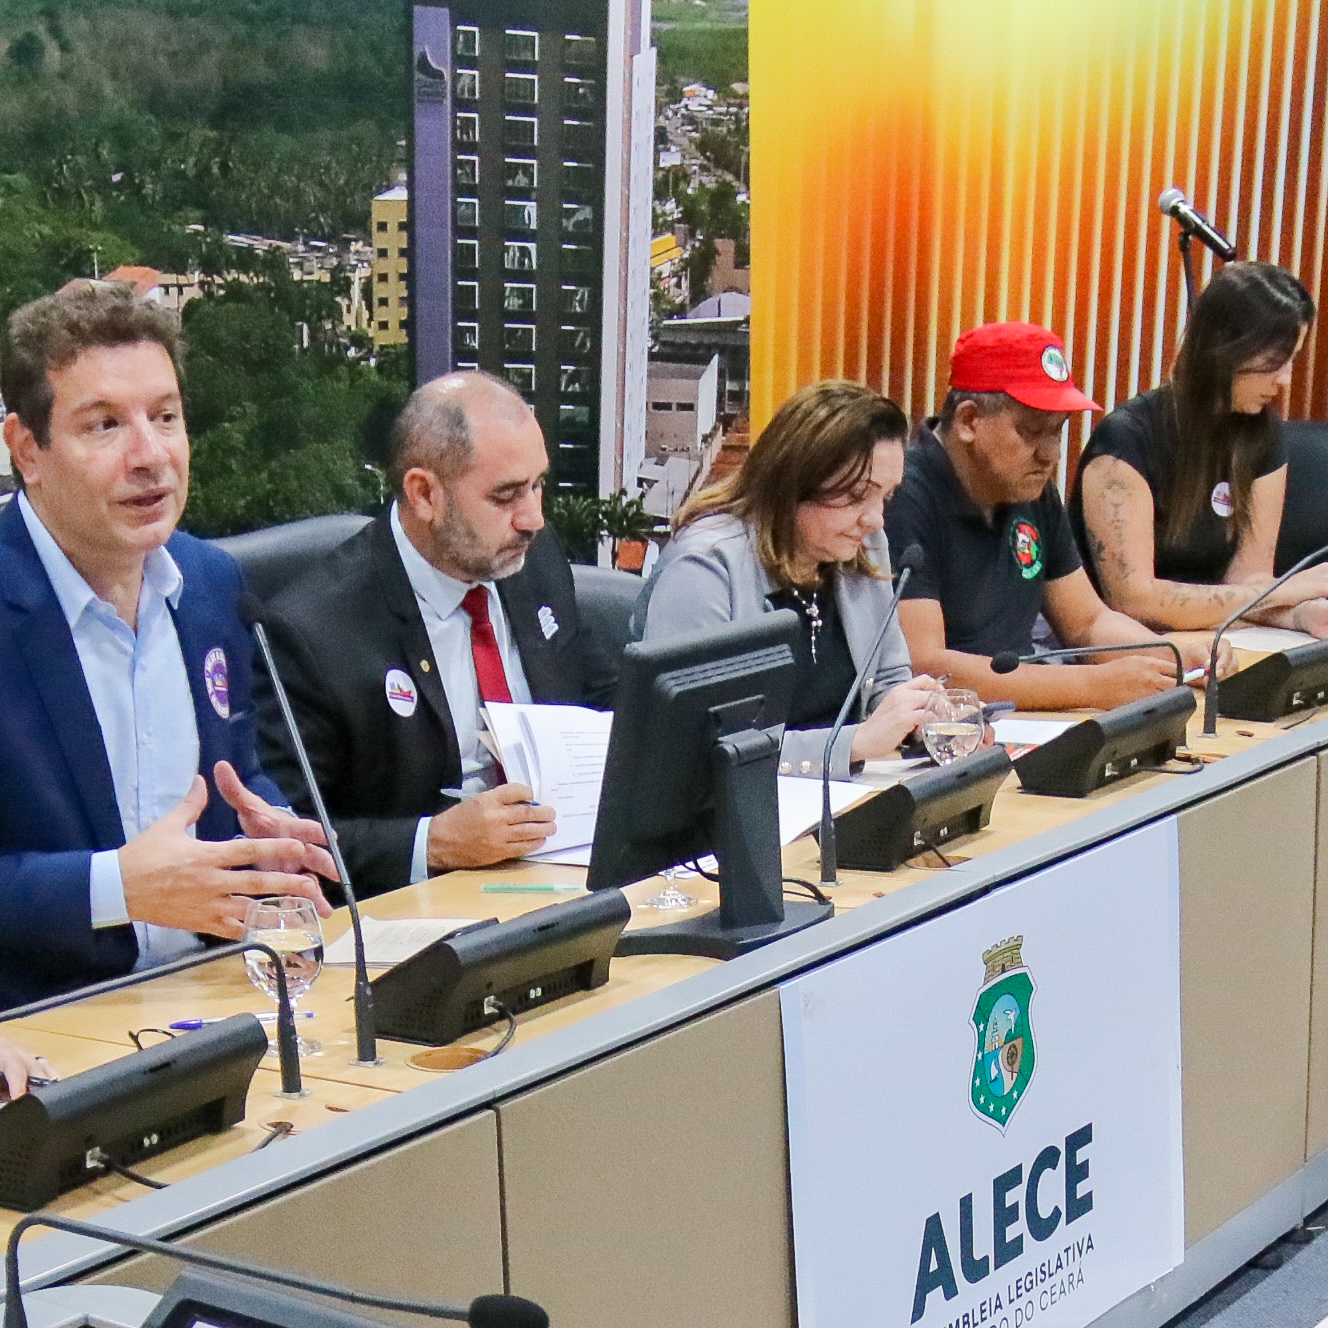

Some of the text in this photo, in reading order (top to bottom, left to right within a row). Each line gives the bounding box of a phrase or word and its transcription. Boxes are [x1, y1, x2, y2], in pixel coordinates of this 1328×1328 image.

[910, 1121, 1094, 1326] ALECE
[1008, 1233, 1095, 1304] LEGISLATIVA
[1039, 1260, 1085, 1312] CEARÁ
